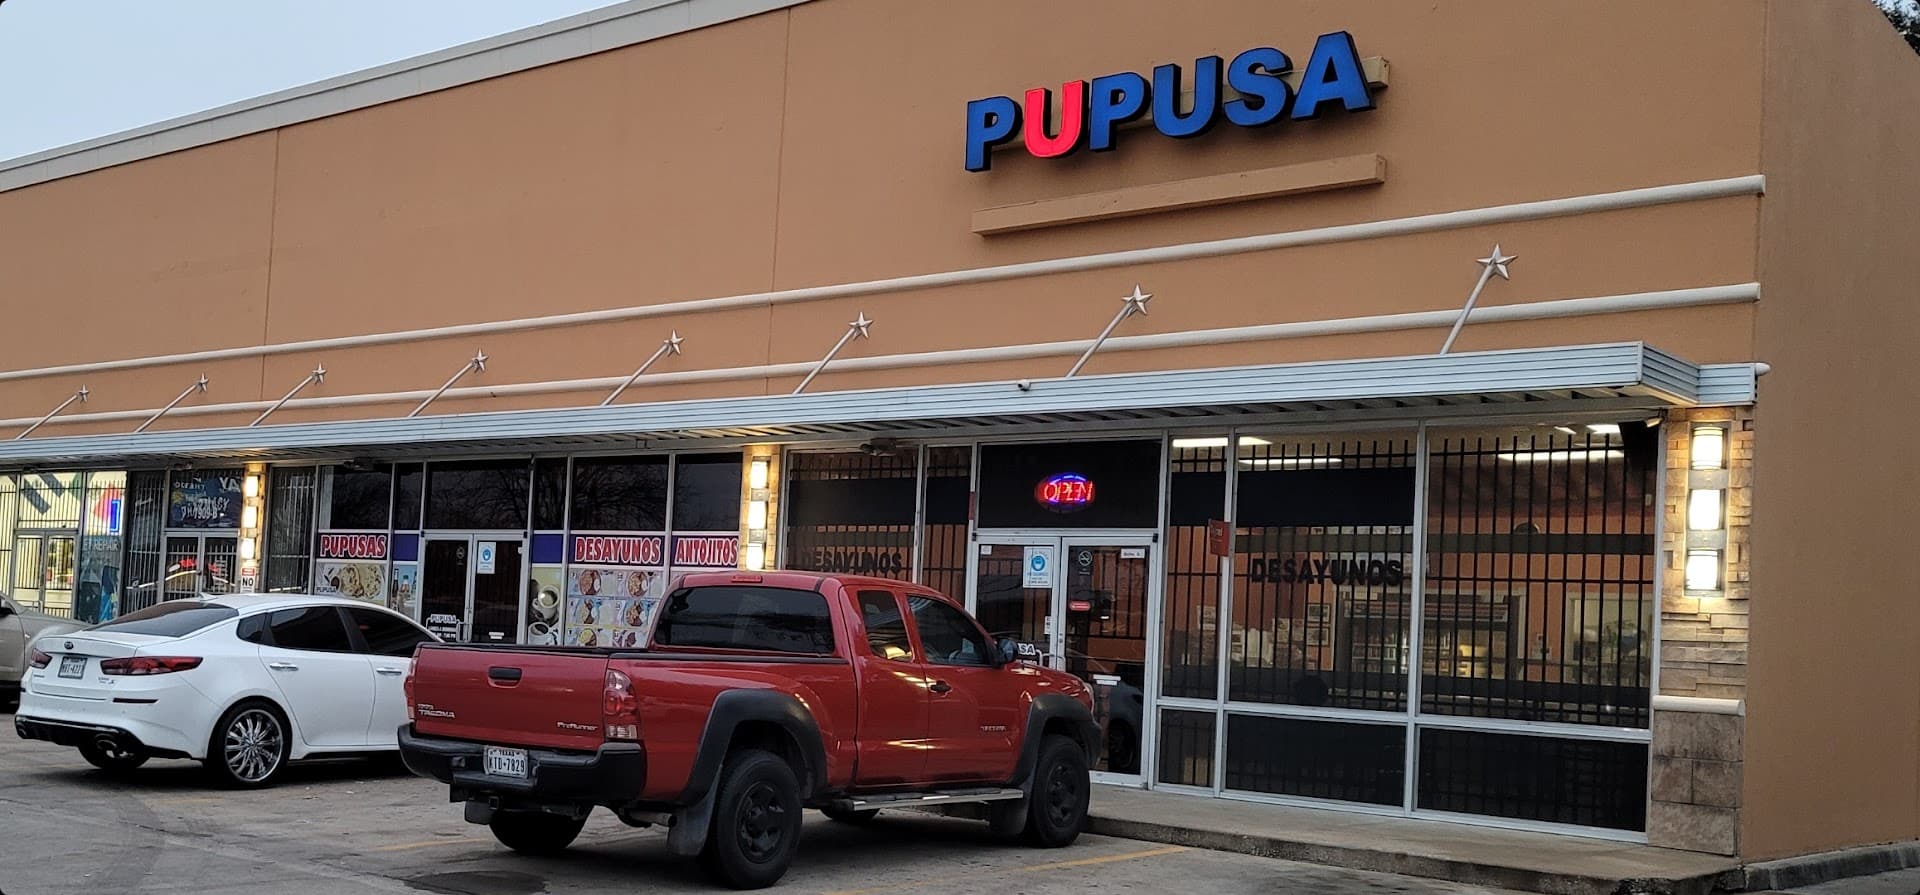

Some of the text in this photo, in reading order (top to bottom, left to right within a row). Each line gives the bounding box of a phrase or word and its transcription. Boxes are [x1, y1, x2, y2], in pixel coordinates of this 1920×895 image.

[965, 30, 1377, 172] PUPUSA
[1044, 480, 1093, 501] OPEN
[320, 534, 387, 558] PUPUSAS
[575, 537, 662, 564] DESAYUNOS
[674, 538, 738, 566] ANTOJITOS
[242, 577, 254, 587] NO
[1251, 558, 1404, 586] DESAYUNOS
[557, 721, 599, 731] PreRunner
